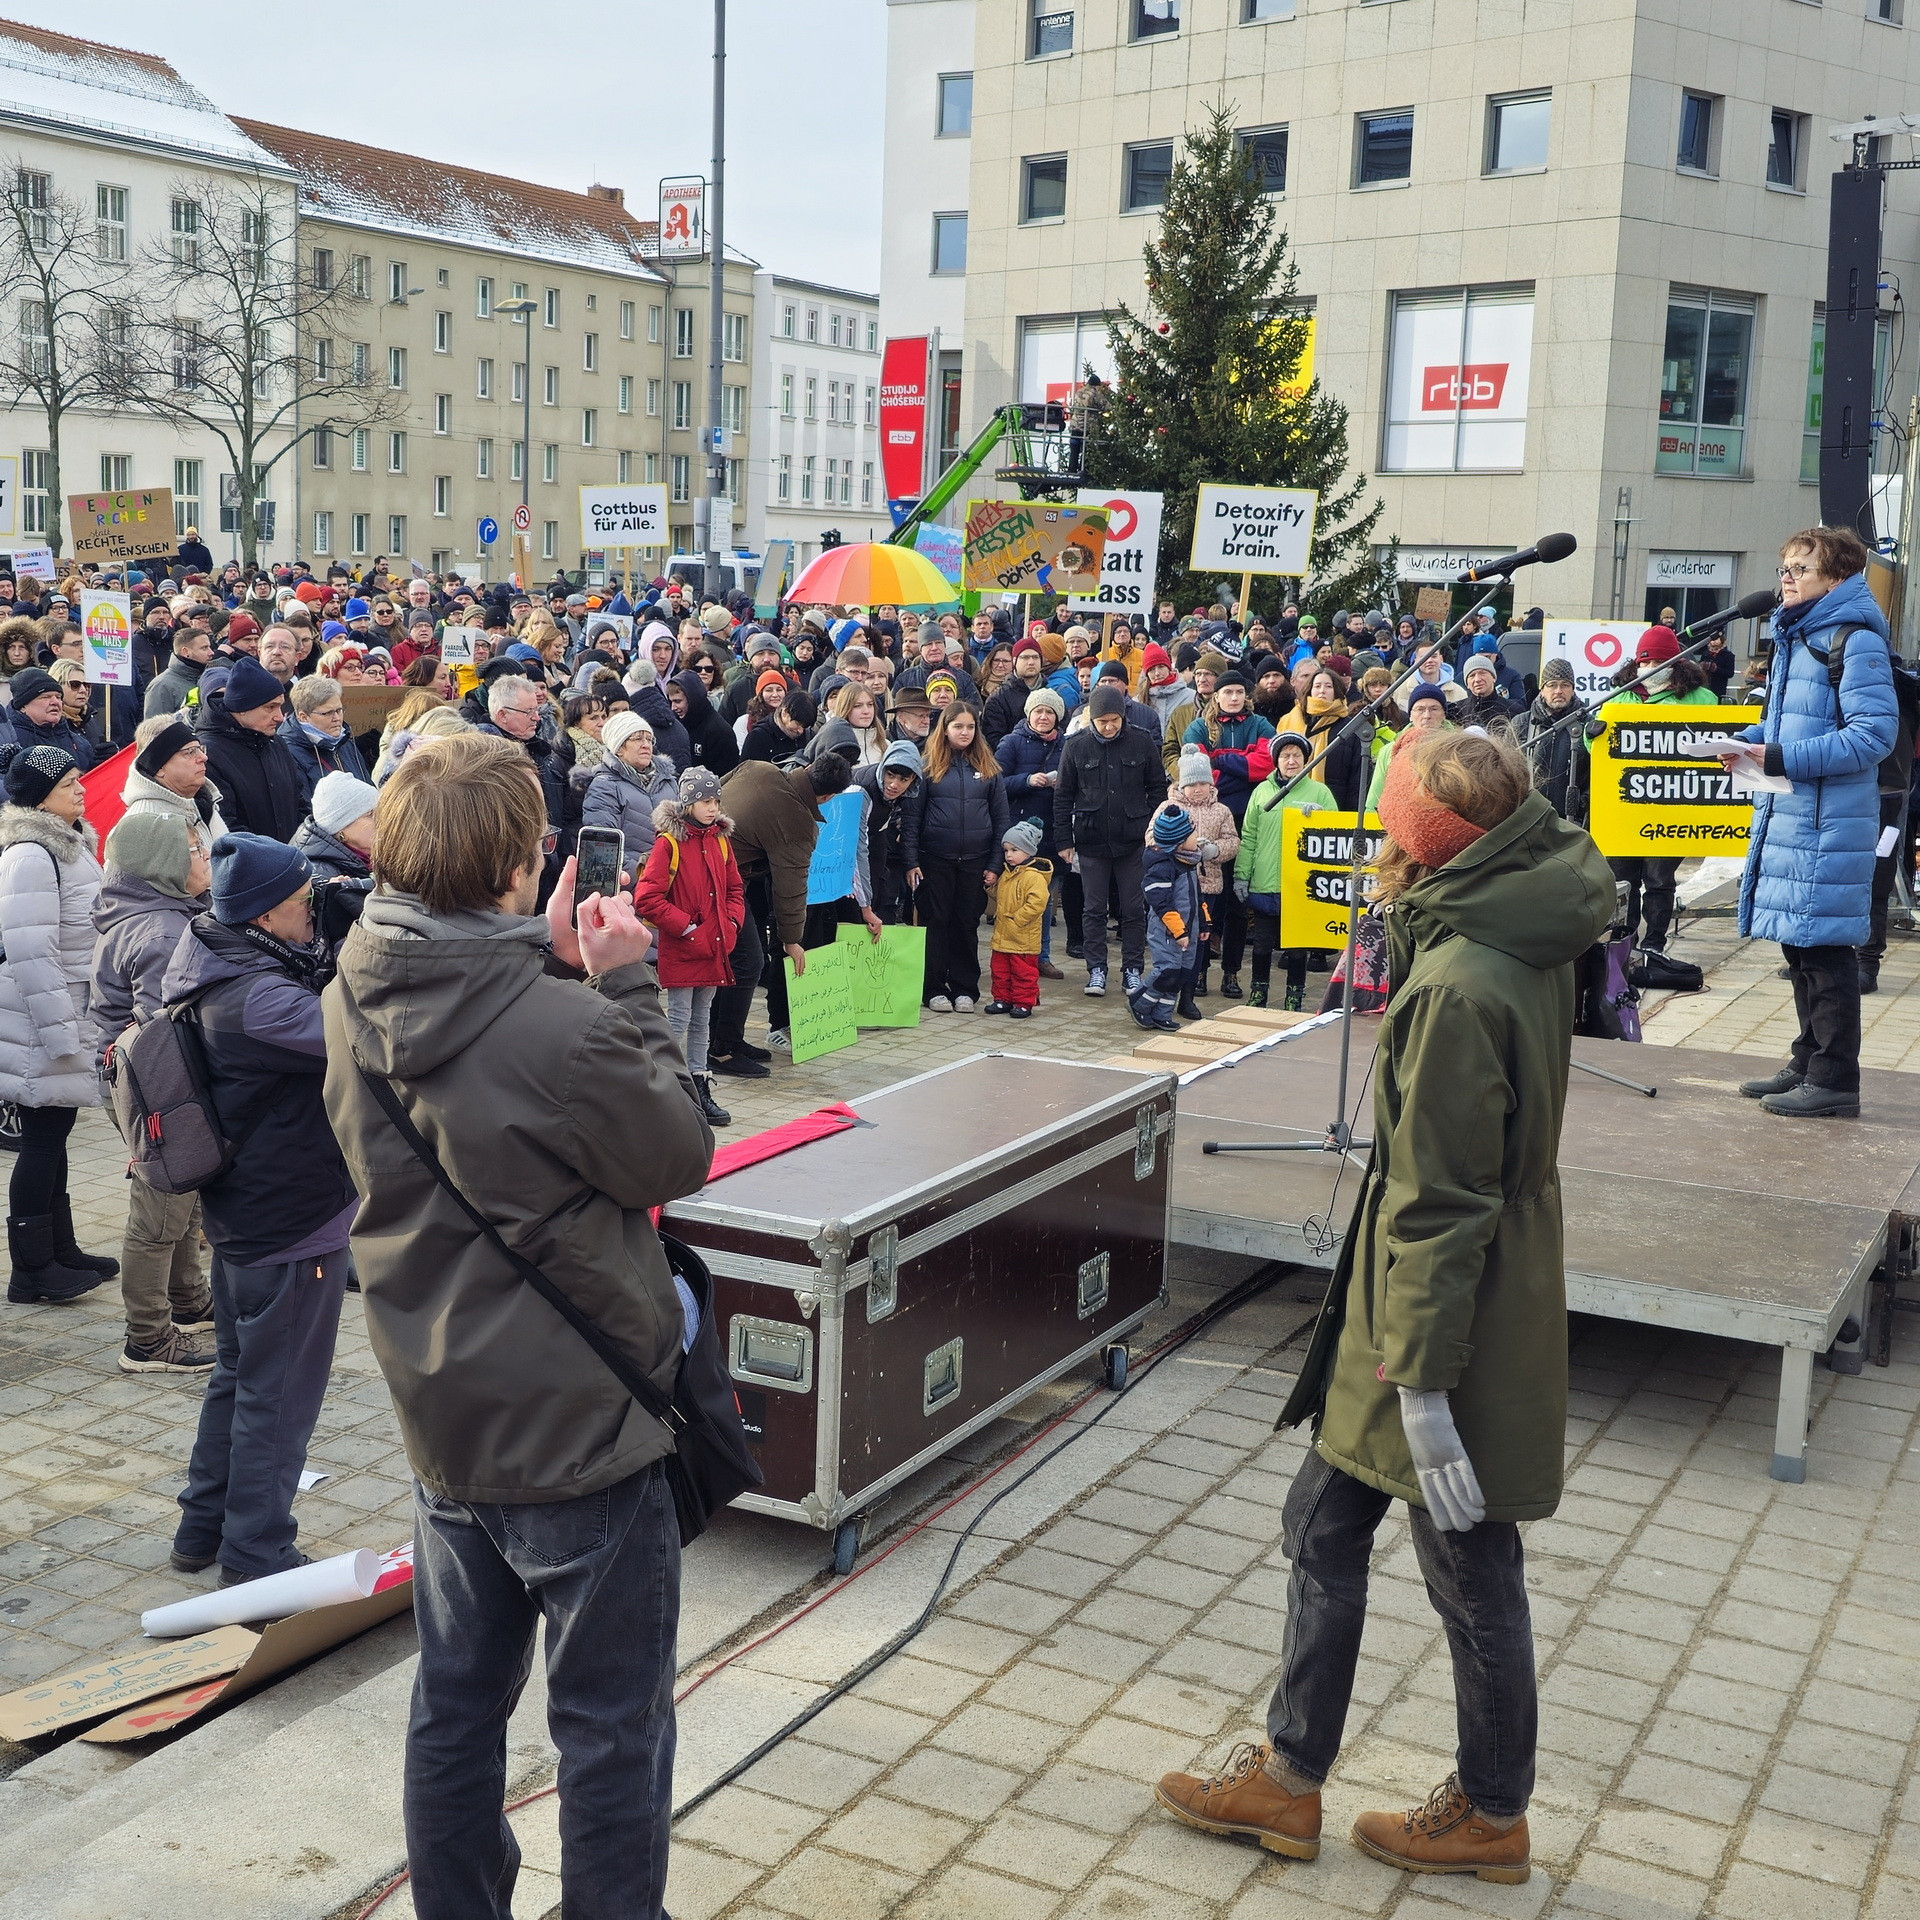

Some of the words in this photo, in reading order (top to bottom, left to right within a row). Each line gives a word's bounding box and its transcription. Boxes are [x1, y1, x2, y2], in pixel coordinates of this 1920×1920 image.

[1040, 15, 1070, 27] Antenne
[663, 187, 702, 199] APOTHEKE
[881, 385, 918, 395] STUDIJO
[1429, 373, 1495, 402] rbb
[891, 433, 912, 442] rbb
[1660, 440, 1677, 451] rbb
[1679, 442, 1726, 457] Anenne
[96, 509, 147, 526] RECHTE
[591, 501, 657, 516] Cottbus
[1215, 501, 1305, 528] Detoxify
[594, 517, 617, 532] für
[621, 517, 655, 531] Alle.
[965, 500, 1016, 543] NAZIS
[964, 508, 1035, 566] FRESSEN
[1231, 522, 1278, 541] your
[76, 535, 126, 550] RECHTE
[109, 541, 170, 557] MENSCHEN
[1221, 538, 1280, 559] brain.
[1100, 548, 1144, 573] tatt
[1660, 556, 1716, 575] Wunderbar
[1079, 584, 1142, 605] ass
[98, 605, 114, 618] KEIN
[92, 617, 119, 634] PLATZ
[102, 634, 122, 647] NAZIS
[1575, 672, 1611, 692] sta
[1630, 770, 1754, 800] SCHÜTZ
[258, 934, 292, 958] SYSTEM
[24, 1640, 219, 1704] Rechts
[59, 1658, 193, 1708] gegen
